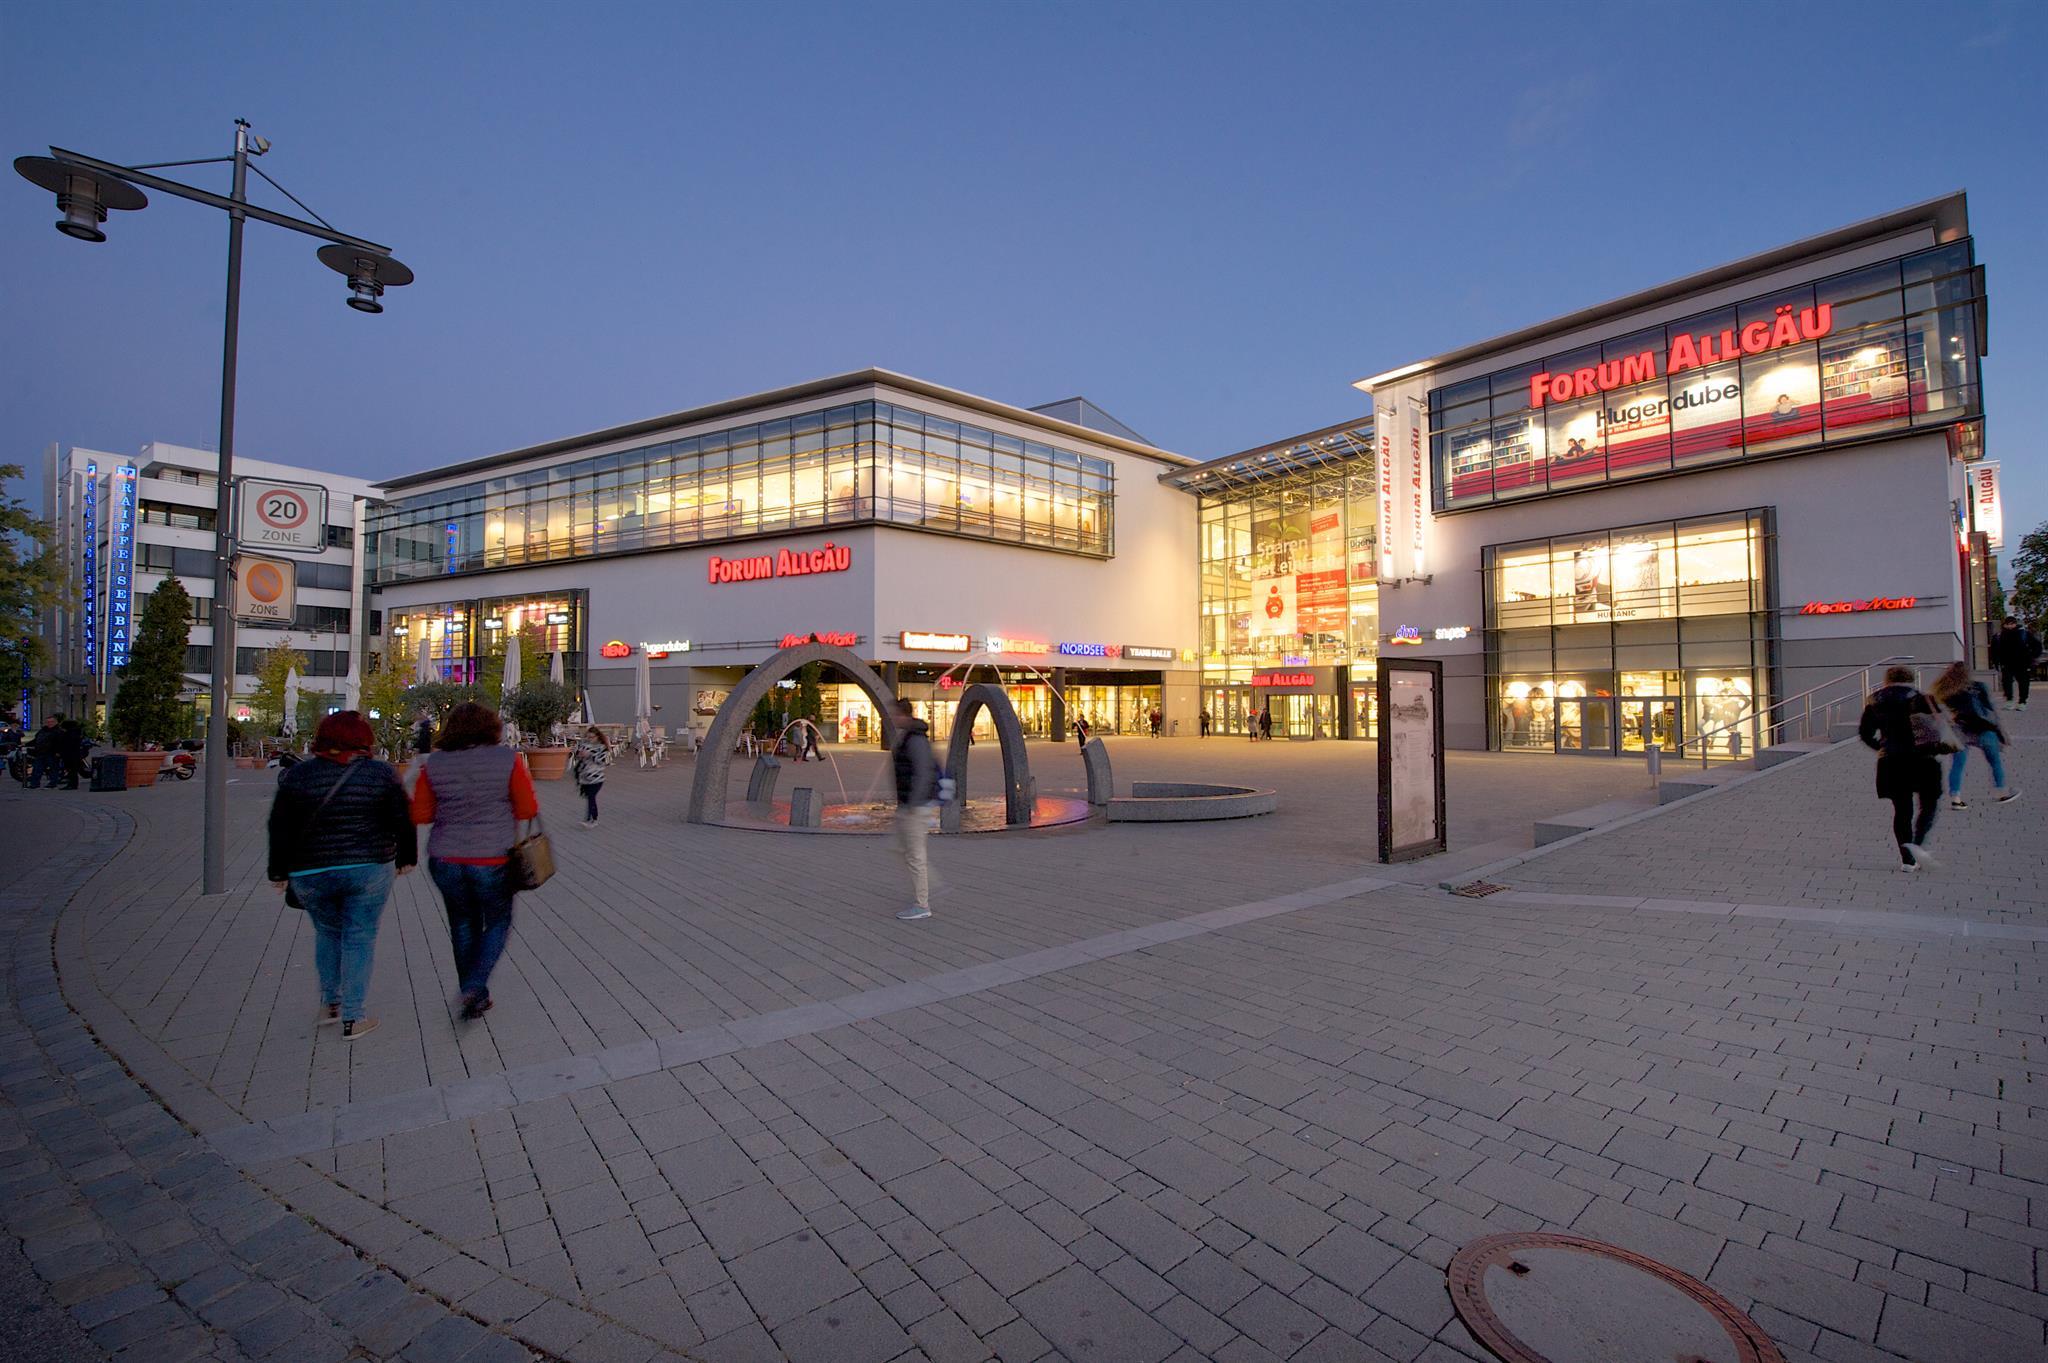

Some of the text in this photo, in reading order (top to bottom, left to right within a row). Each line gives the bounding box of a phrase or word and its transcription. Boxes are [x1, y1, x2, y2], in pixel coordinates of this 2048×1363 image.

[1530, 303, 1832, 409] FORUM ALLGÄU
[1596, 384, 1739, 428] Hugendube
[1411, 428, 1421, 490] ALLGÄU
[1978, 468, 1994, 503] ALLGÄU
[1380, 436, 1393, 555] FORUM ALLGÄU
[268, 500, 297, 519] 20
[262, 530, 302, 543] ZONE
[1257, 538, 1308, 558] Sparen
[709, 543, 850, 584] FORUM ALLGÄU
[112, 483, 132, 666] RAIFFEISENBANK
[250, 604, 279, 616] ZONE
[1800, 596, 1917, 614] Media Markt
[1396, 624, 1418, 638] dm
[602, 645, 629, 657] RENO
[1061, 643, 1104, 656] NORDSEE
[1272, 672, 1315, 687] ALLGÄU
